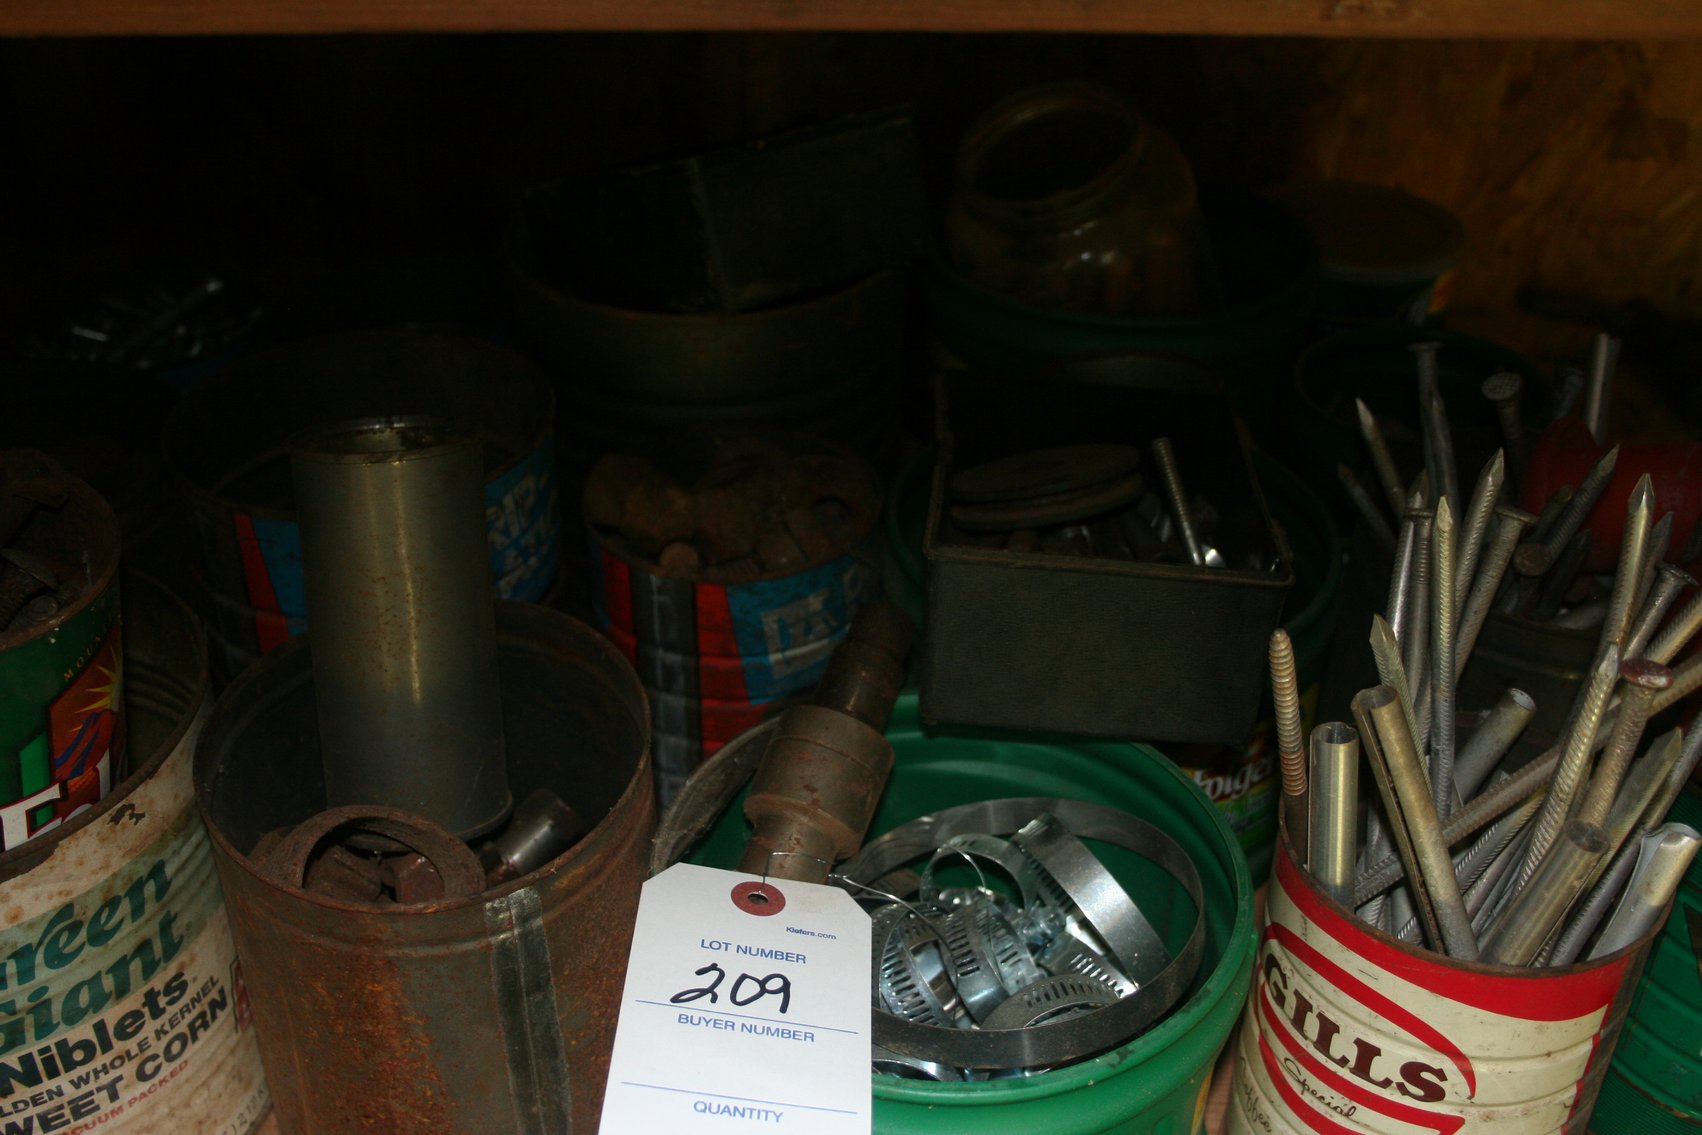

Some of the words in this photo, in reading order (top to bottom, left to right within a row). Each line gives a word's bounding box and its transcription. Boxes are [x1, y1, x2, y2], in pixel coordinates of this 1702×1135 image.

[0, 859, 172, 992] reen
[700, 938, 732, 951] LOT
[736, 945, 806, 964] NUMBER
[670, 962, 791, 1014] 209
[677, 1013, 735, 1031] BUYER
[740, 1024, 815, 1042] NUMBER
[1263, 952, 1447, 1102] GILLS
[0, 971, 188, 1098] Niblets
[0, 1084, 65, 1118] LDEN
[69, 1038, 151, 1090] WHOLE
[154, 975, 219, 1041] KERNEL
[0, 1074, 124, 1135] WEET
[136, 986, 228, 1083] CORN
[128, 1060, 189, 1108] PACKED
[693, 1100, 783, 1123] QUANTITY
